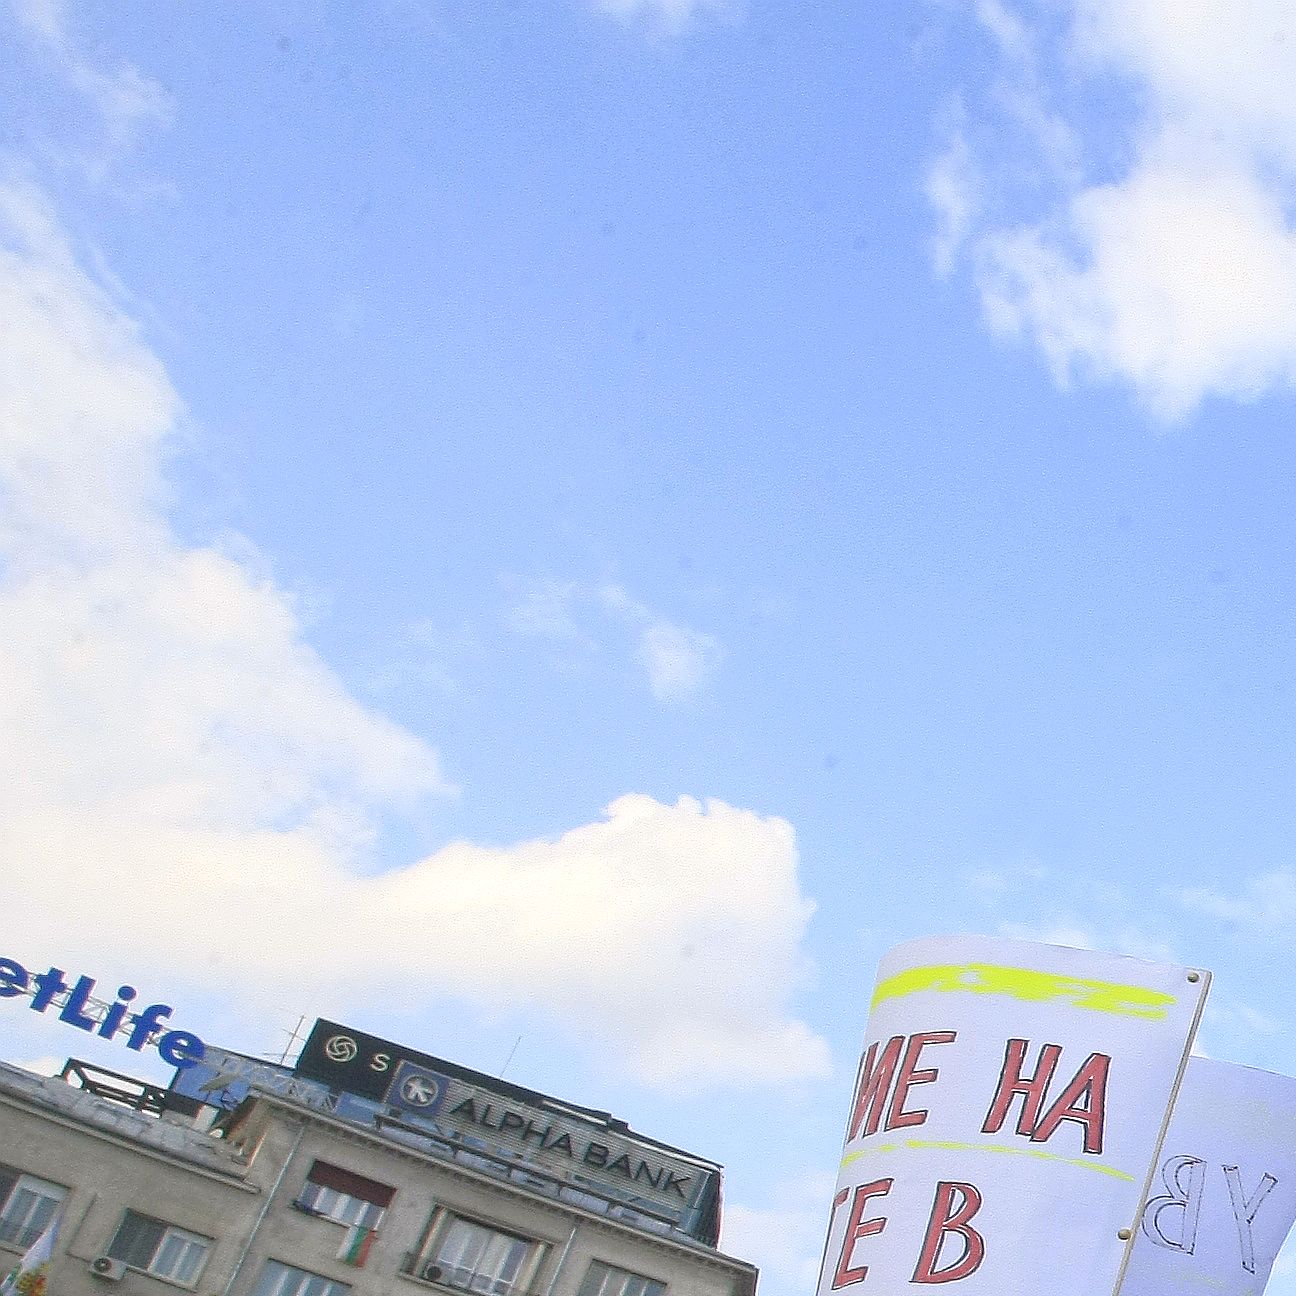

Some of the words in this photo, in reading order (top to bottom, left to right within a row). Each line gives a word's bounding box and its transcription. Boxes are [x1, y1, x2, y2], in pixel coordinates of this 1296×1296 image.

[449, 1097, 574, 1158] ALPHA
[583, 1143, 693, 1198] BANK
[981, 1037, 1112, 1155] НА
[909, 1180, 986, 1284] В
